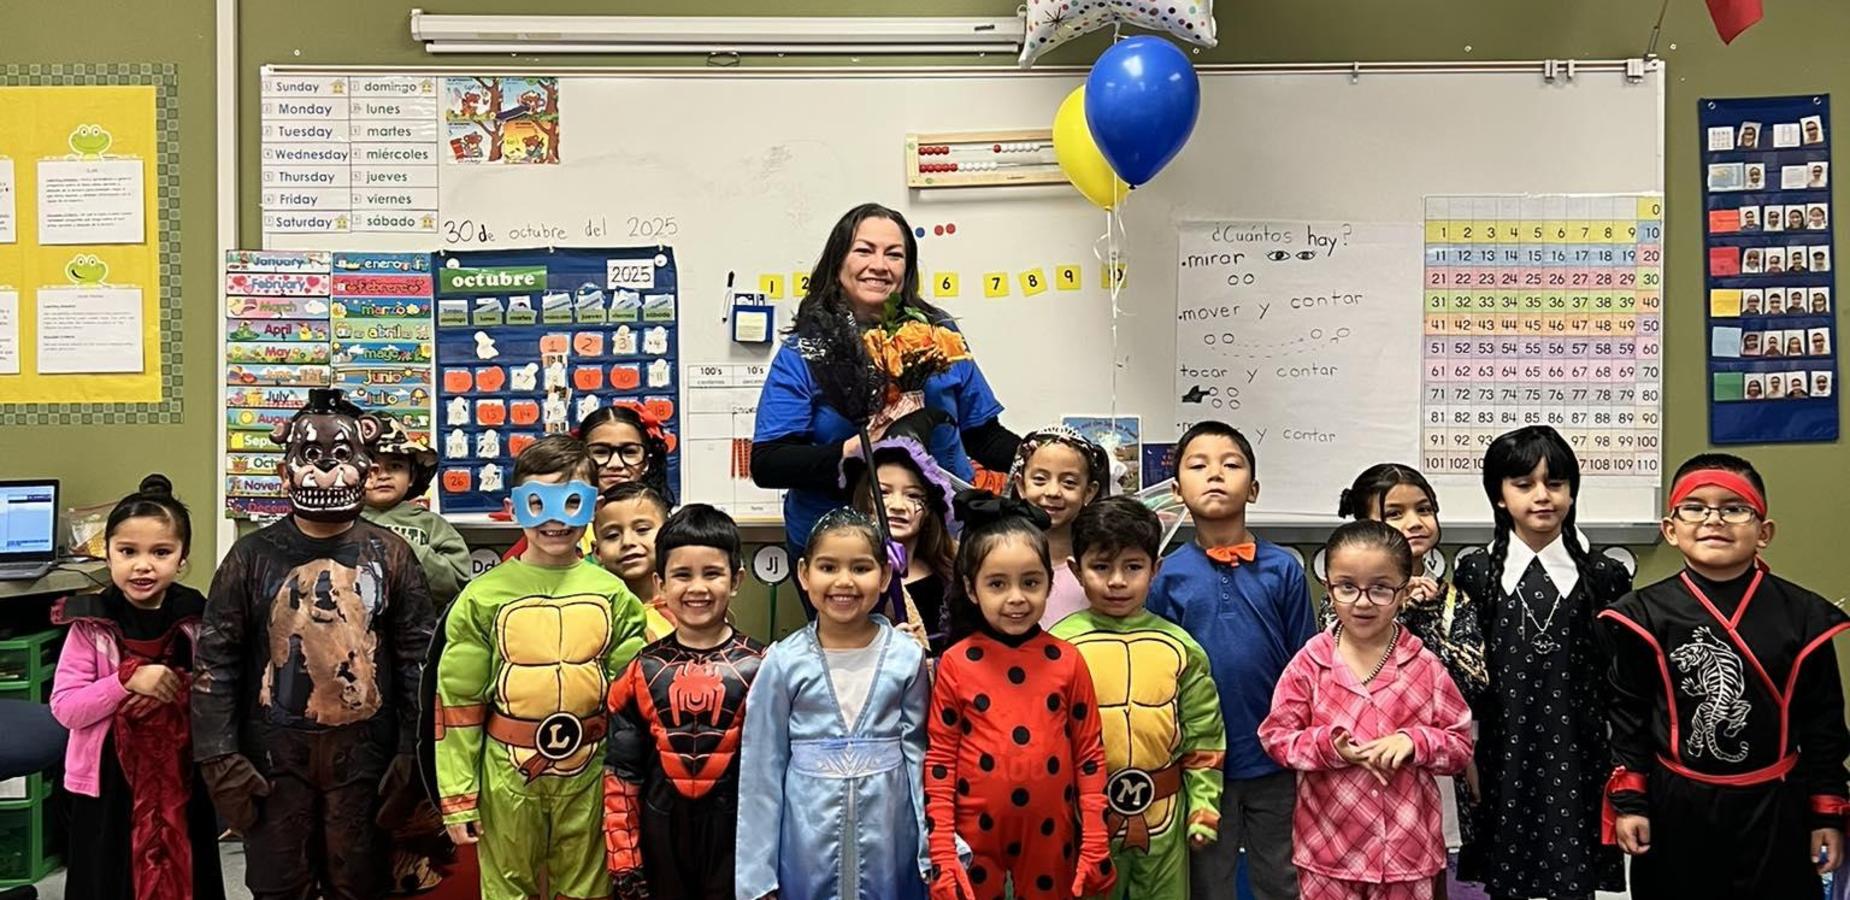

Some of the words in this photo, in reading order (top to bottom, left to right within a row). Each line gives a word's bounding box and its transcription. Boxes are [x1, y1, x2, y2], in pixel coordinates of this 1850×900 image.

[276, 82, 319, 94] Sunday
[364, 82, 417, 94] domingo
[279, 104, 332, 116] Monday
[366, 103, 401, 114] lunes
[279, 126, 333, 139] Tuesday
[367, 126, 412, 137] martes
[275, 148, 348, 162] Wednesday
[367, 148, 429, 160] miércoles
[279, 171, 335, 184] Thursday
[366, 171, 408, 184] jueves
[280, 193, 318, 206] Friday
[367, 194, 412, 205] viernes
[1651, 203, 1660, 215] 0
[276, 217, 332, 230] Saturday
[367, 215, 416, 227] sábado
[444, 220, 474, 244] 30
[478, 224, 495, 243] de
[509, 223, 567, 241] octubre
[584, 218, 607, 237] del
[627, 217, 678, 239] 2025
[1212, 224, 1293, 245] ¿Cuántos
[1441, 226, 1446, 238] 1
[1463, 226, 1472, 238] 2
[1487, 226, 1496, 239] 3
[1510, 227, 1518, 238] 4
[1533, 226, 1542, 239] 5
[1557, 227, 1565, 239] 6
[1581, 226, 1589, 238] 7
[1604, 226, 1612, 239] 8
[1627, 226, 1636, 238] 9
[1645, 226, 1660, 239] 10
[1187, 251, 1245, 268] mirar
[1436, 250, 1446, 261] 11
[1458, 249, 1472, 261] 12
[1481, 249, 1495, 262] 13
[1504, 250, 1518, 261] 14
[1528, 249, 1542, 262] 15
[1551, 250, 1565, 262] 16
[1575, 249, 1589, 261] 17
[1599, 250, 1613, 262] 18
[1622, 250, 1636, 261] 19
[1643, 249, 1660, 262] 20
[253, 257, 305, 269] January
[364, 259, 402, 269] enero
[452, 270, 535, 288] octubre
[611, 266, 652, 283] 2025
[1027, 274, 1038, 288] 8
[1064, 269, 1074, 283] 9
[1431, 272, 1445, 284] 21
[1455, 272, 1471, 284] 22
[1478, 272, 1495, 285] 23
[1501, 273, 1517, 285] 24
[1525, 272, 1542, 285] 25
[1548, 273, 1565, 285] 26
[1572, 272, 1588, 285] 27
[1595, 273, 1612, 285] 28
[1619, 273, 1636, 285] 29
[1643, 272, 1659, 285] 30
[251, 278, 305, 292] February
[801, 276, 809, 290] 2
[942, 276, 951, 290] 6
[992, 277, 1000, 290] 7
[1182, 304, 1241, 321] mover
[1259, 303, 1270, 320] y
[1290, 291, 1363, 309] contar
[1431, 295, 1445, 308] 31
[1455, 295, 1471, 308] 32
[1478, 295, 1495, 308] 33
[1501, 296, 1518, 308] 34
[1525, 296, 1542, 308] 35
[1548, 296, 1565, 308] 36
[1572, 296, 1588, 308] 37
[1595, 296, 1612, 308] 38
[1619, 296, 1635, 308] 39
[1642, 296, 1660, 308] 40
[264, 323, 292, 337] April
[368, 323, 402, 339] abril
[1431, 319, 1445, 330] 41
[1454, 319, 1471, 331] 42
[1477, 319, 1495, 331] 43
[1501, 319, 1517, 329] 44
[1524, 319, 1541, 331] 45
[1548, 319, 1565, 331] 46
[1571, 319, 1588, 330] 47
[1595, 319, 1612, 332] 48
[1618, 319, 1635, 331] 49
[1643, 319, 1659, 332] 50
[581, 337, 593, 352] 2
[618, 338, 627, 350] 3
[1431, 342, 1445, 354] 51
[1454, 342, 1471, 354] 52
[1478, 342, 1494, 354] 53
[1501, 342, 1517, 354] 54
[1525, 342, 1541, 354] 55
[1548, 342, 1564, 354] 56
[1571, 342, 1588, 355] 57
[1595, 342, 1612, 355] 58
[1618, 342, 1635, 355] 59
[1642, 343, 1659, 355] 60
[264, 346, 291, 359] May
[364, 349, 399, 361] mayo
[363, 369, 403, 385] junio
[700, 367, 722, 375] 100's
[747, 366, 764, 375] 10's
[1179, 364, 1228, 378] tocar
[1247, 368, 1258, 383] y
[1277, 363, 1339, 378] contar
[1431, 365, 1445, 377] 61
[1454, 365, 1471, 377] 62
[1478, 365, 1494, 377] 63
[1501, 366, 1517, 377] 64
[1524, 365, 1540, 378] 65
[1548, 366, 1564, 377] 66
[1571, 366, 1588, 378] 67
[1595, 365, 1611, 378] 68
[1618, 366, 1634, 378] 69
[1642, 365, 1659, 378] 70
[265, 390, 290, 402] July
[1255, 428, 1268, 444] y
[1283, 428, 1336, 444] contar
[451, 475, 464, 487] 26
[766, 556, 778, 575] Jj
[547, 723, 570, 749] L
[1116, 778, 1148, 806] M
